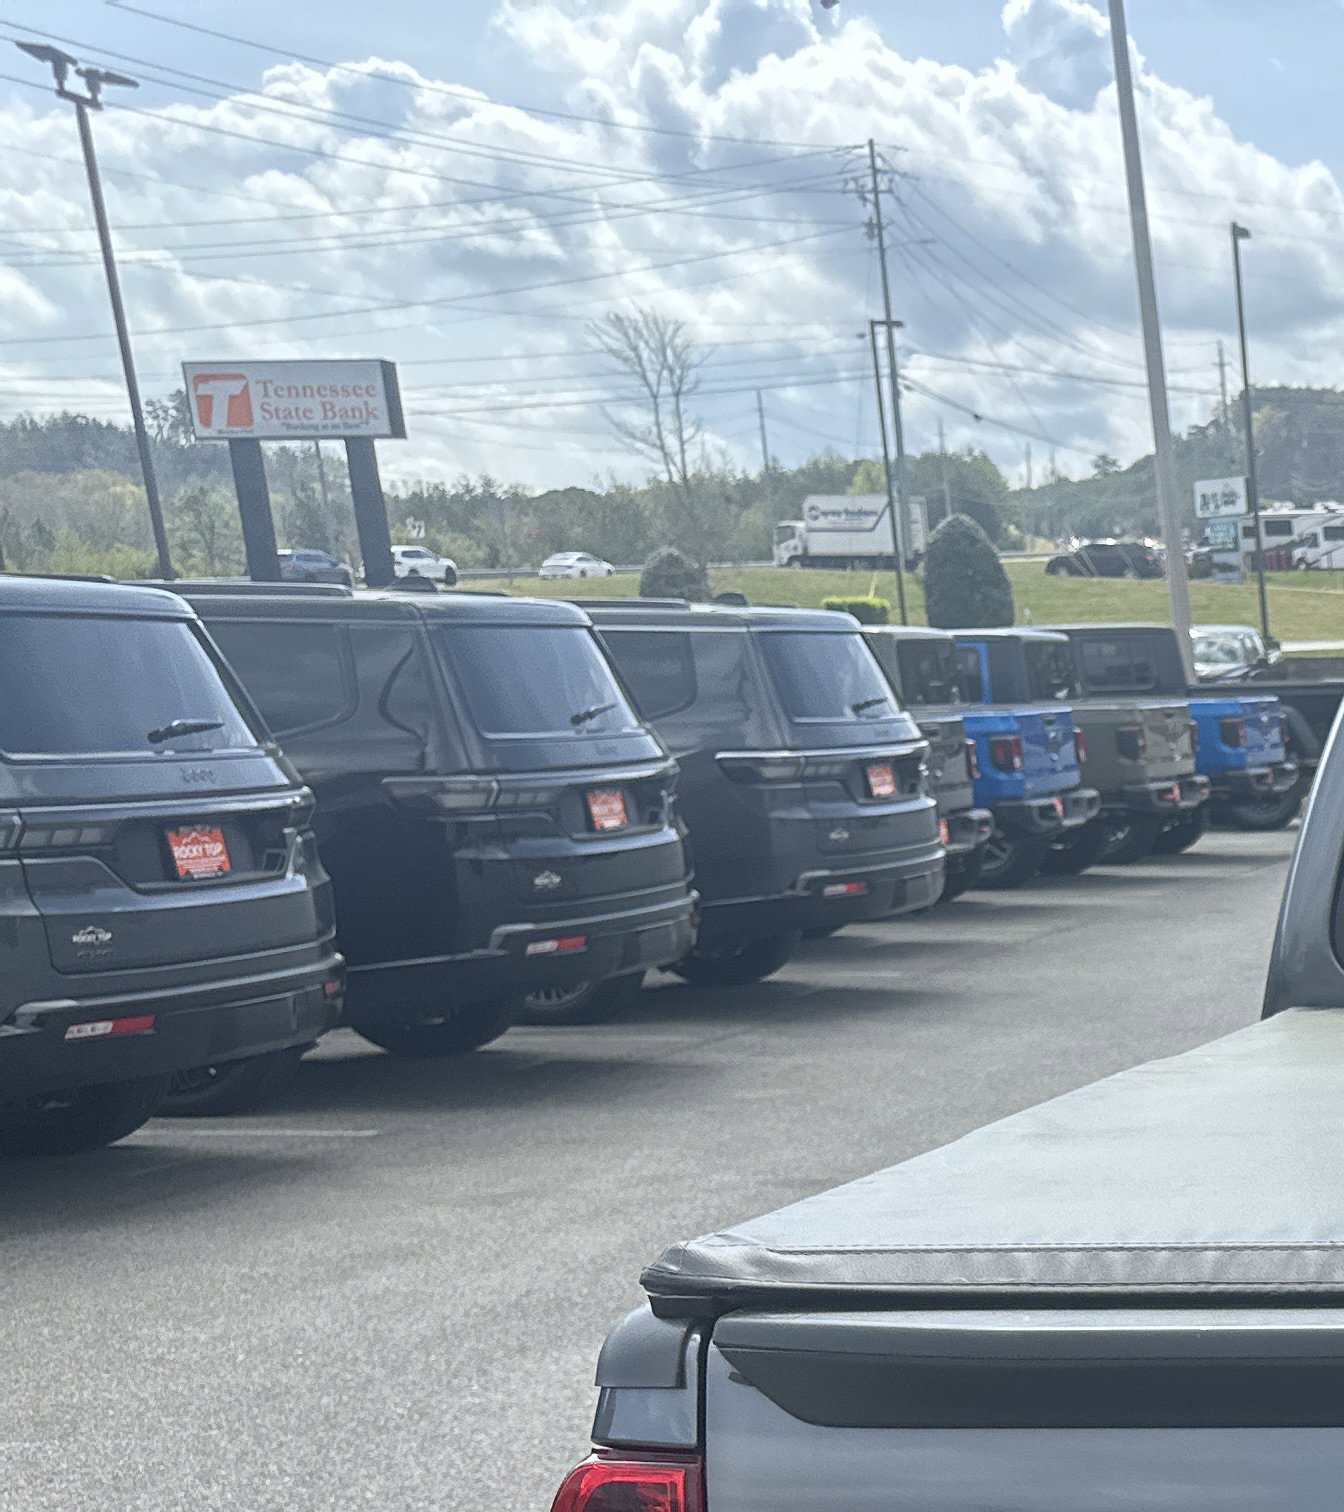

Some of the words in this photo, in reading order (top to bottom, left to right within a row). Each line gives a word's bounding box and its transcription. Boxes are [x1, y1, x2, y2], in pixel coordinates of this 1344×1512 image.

[255, 379, 377, 399] Tennessee
[259, 402, 313, 421] State
[320, 401, 378, 420] Bank
